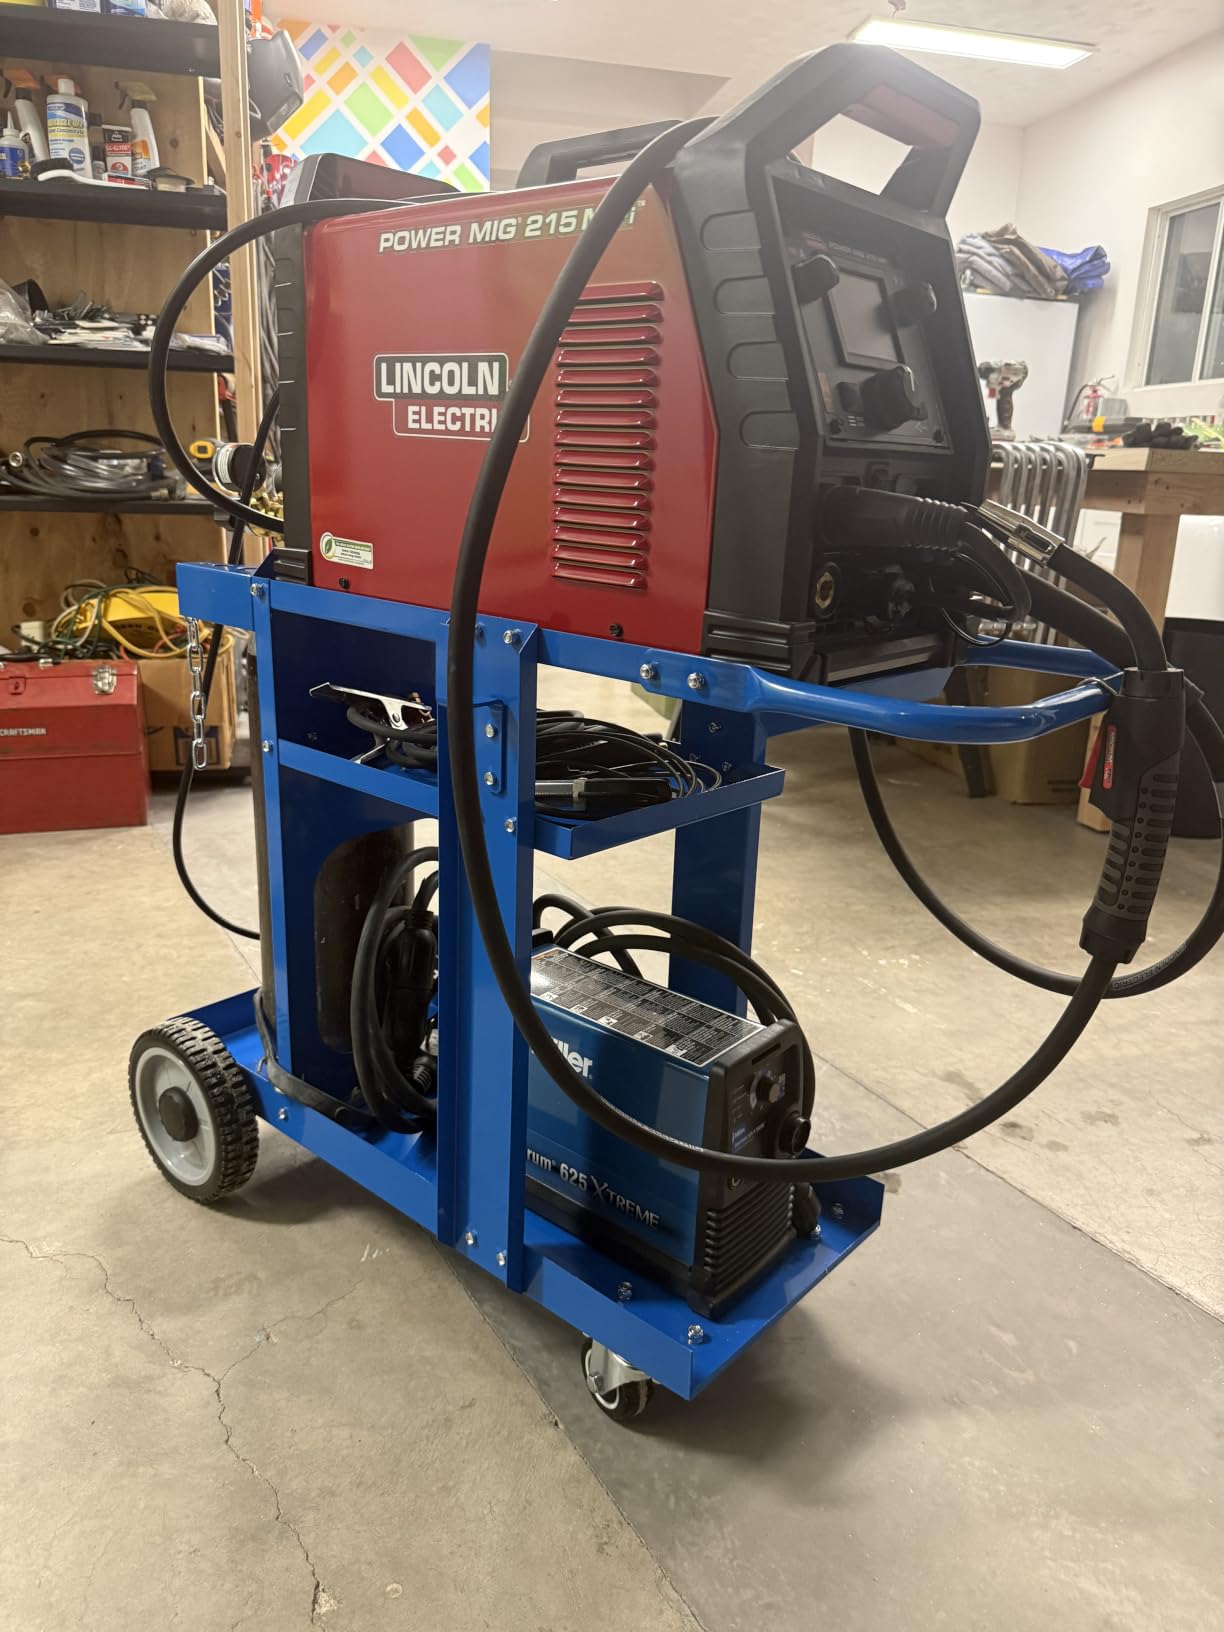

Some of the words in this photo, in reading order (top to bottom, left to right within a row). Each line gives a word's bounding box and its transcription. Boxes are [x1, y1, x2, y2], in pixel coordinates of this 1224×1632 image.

[379, 225, 462, 252] POWER
[525, 210, 579, 236] 215
[381, 361, 500, 395] LINCOLN
[407, 405, 498, 433] ELECTRI
[559, 1163, 588, 1191] 625
